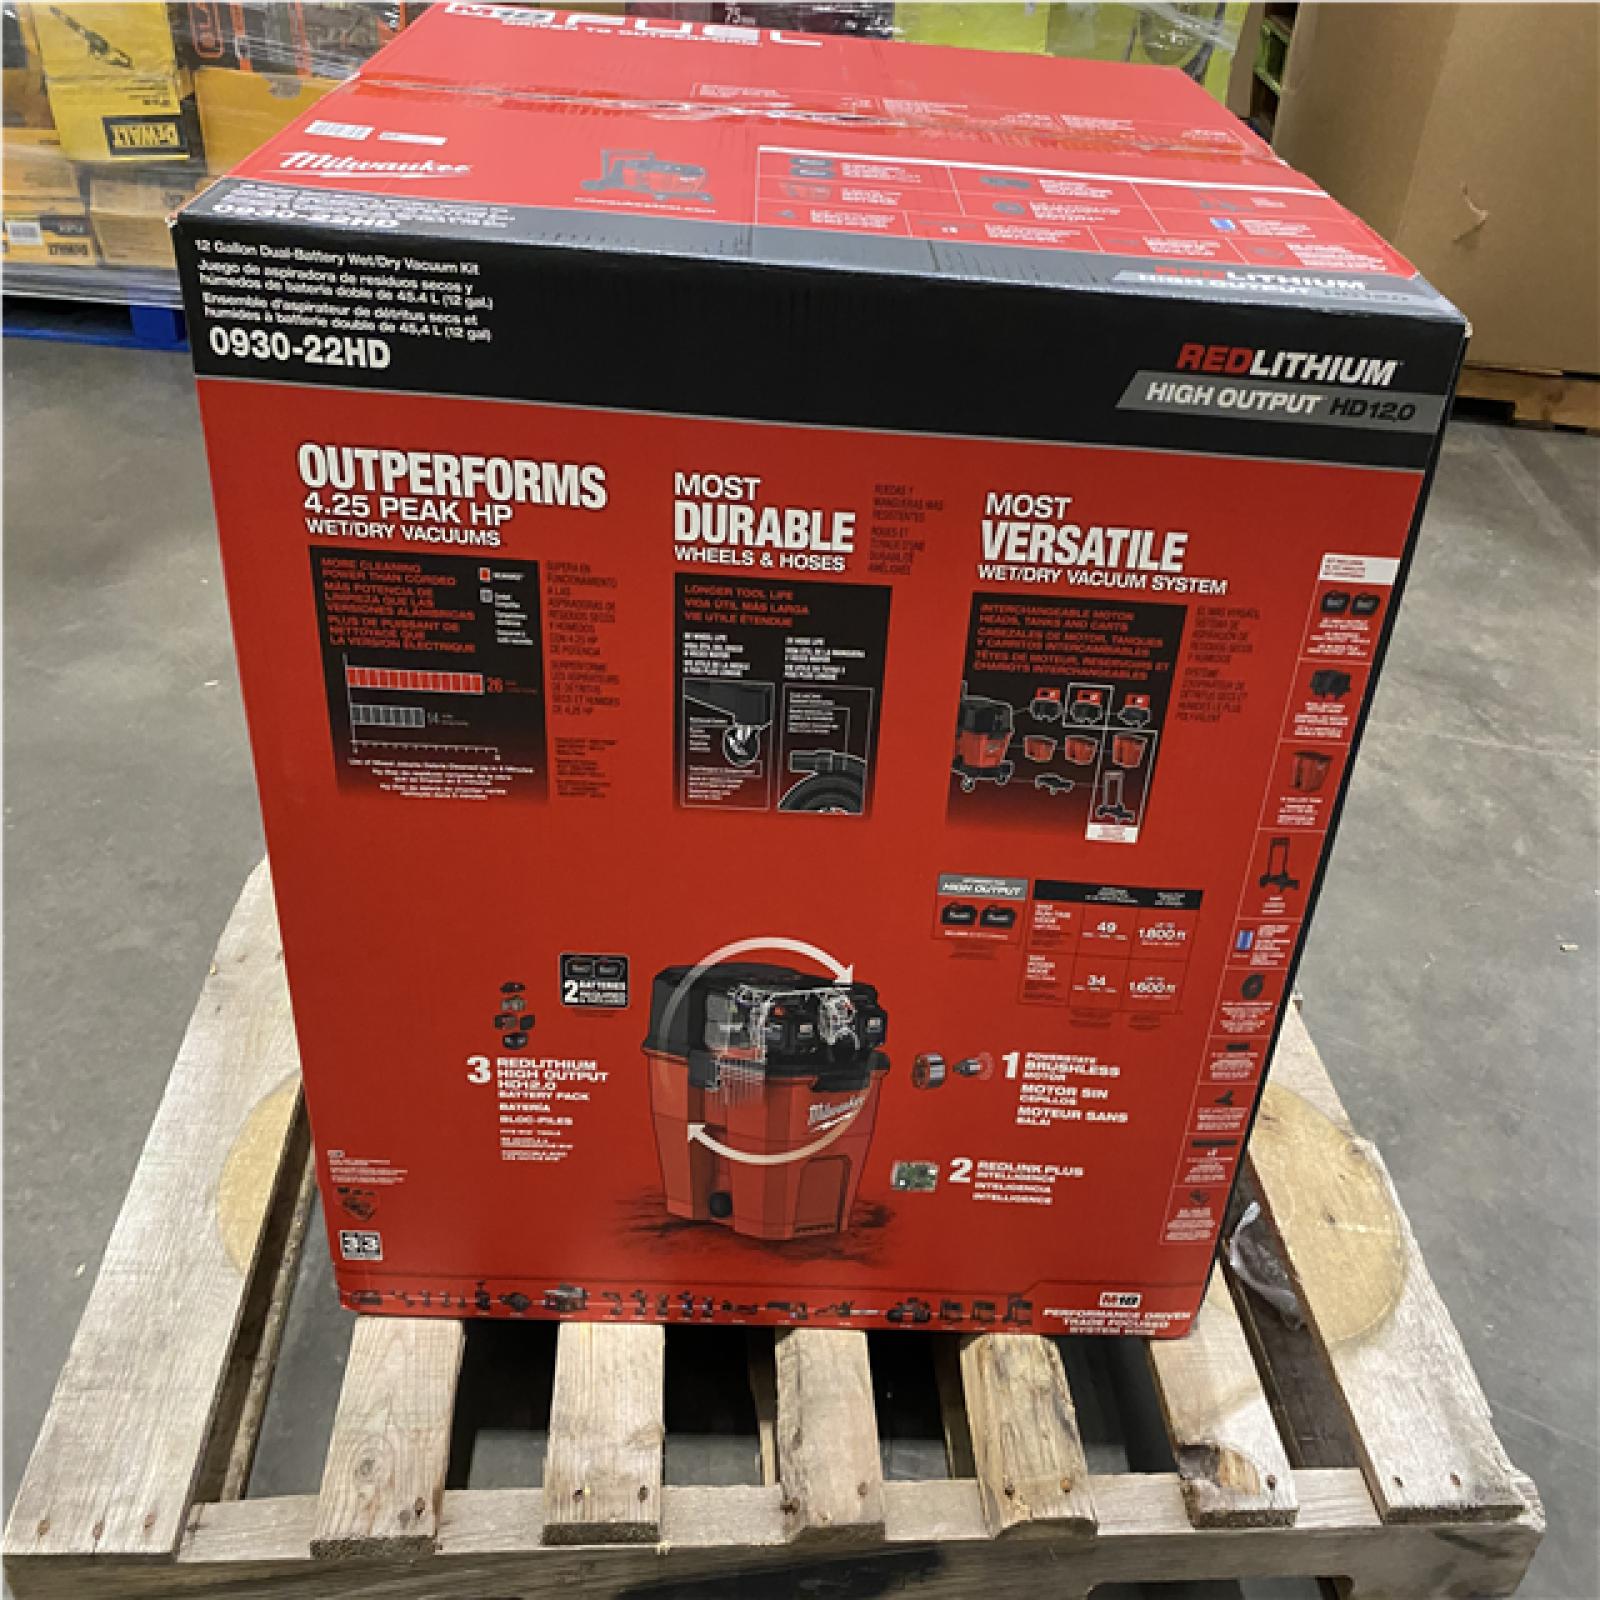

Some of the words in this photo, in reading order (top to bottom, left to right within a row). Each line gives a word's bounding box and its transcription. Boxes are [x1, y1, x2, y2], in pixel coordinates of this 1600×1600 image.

[110, 124, 180, 148] DEWALT
[279, 150, 472, 172] Milwaukee
[214, 240, 257, 255] Gallon
[259, 245, 345, 267] Dual-Battery
[347, 252, 400, 270] Wet/Dry
[402, 257, 458, 273] Vacuum
[460, 261, 480, 275] Kit
[197, 259, 240, 275] Juego
[242, 262, 260, 275] de
[360, 274, 418, 288] residuos
[421, 280, 461, 291] secos
[335, 285, 372, 298] doble
[202, 291, 268, 308] Ensemble
[429, 312, 460, 325] secs
[209, 325, 391, 369] 0930-22HD
[1176, 342, 1399, 387] REDLITHIUM
[1145, 382, 1215, 406] HIGH
[1217, 388, 1321, 415] OUTPUT
[298, 443, 608, 509] OUTPERFORMS
[674, 471, 762, 500] MOST
[304, 491, 370, 518] 4.25
[379, 496, 461, 525] PEAK
[469, 502, 514, 527] HP
[985, 491, 1072, 520] MOST
[305, 517, 395, 540] WET/DRY
[400, 525, 501, 546] VACUUMS
[674, 499, 856, 553] DURABLE
[674, 545, 755, 566] WHEELS
[759, 552, 774, 569] &
[779, 553, 846, 572] HOSES
[982, 519, 1188, 573] VERSATILE
[320, 557, 356, 569] MORE
[684, 584, 735, 598] LONGER
[736, 587, 767, 600] TOOL
[769, 589, 794, 602] LIFE
[978, 564, 1061, 584] WET/DRY
[1068, 569, 1146, 590] VACUUM
[1152, 575, 1228, 595] SYSTEM
[684, 598, 711, 611] VIDA
[769, 604, 810, 616] LARGA
[684, 610, 704, 622] VIE
[705, 612, 738, 625] UTILE
[1096, 921, 1117, 934] 49
[564, 979, 579, 1004] 2
[466, 1055, 491, 1084] 3
[496, 1057, 597, 1071] REDLITHIUM
[497, 1069, 539, 1080] HIGH
[543, 1070, 610, 1083] OUTPUT
[1001, 1051, 1020, 1079] 1
[1023, 1071, 1067, 1082] MOTOR
[1024, 1060, 1121, 1077] BRUSHLESS
[497, 1091, 553, 1101] BATTERY
[555, 1091, 591, 1101] PACK
[1020, 1084, 1079, 1097] MOTOR
[1081, 1088, 1109, 1100] SIN
[1017, 1106, 1083, 1121] MOTEUR
[1085, 1110, 1129, 1124] SANS
[948, 1157, 974, 1184] 2
[977, 1160, 1042, 1175] REDLINK
[1044, 1165, 1084, 1178] PLUS
[1144, 1311, 1191, 1321] DRIVEN
